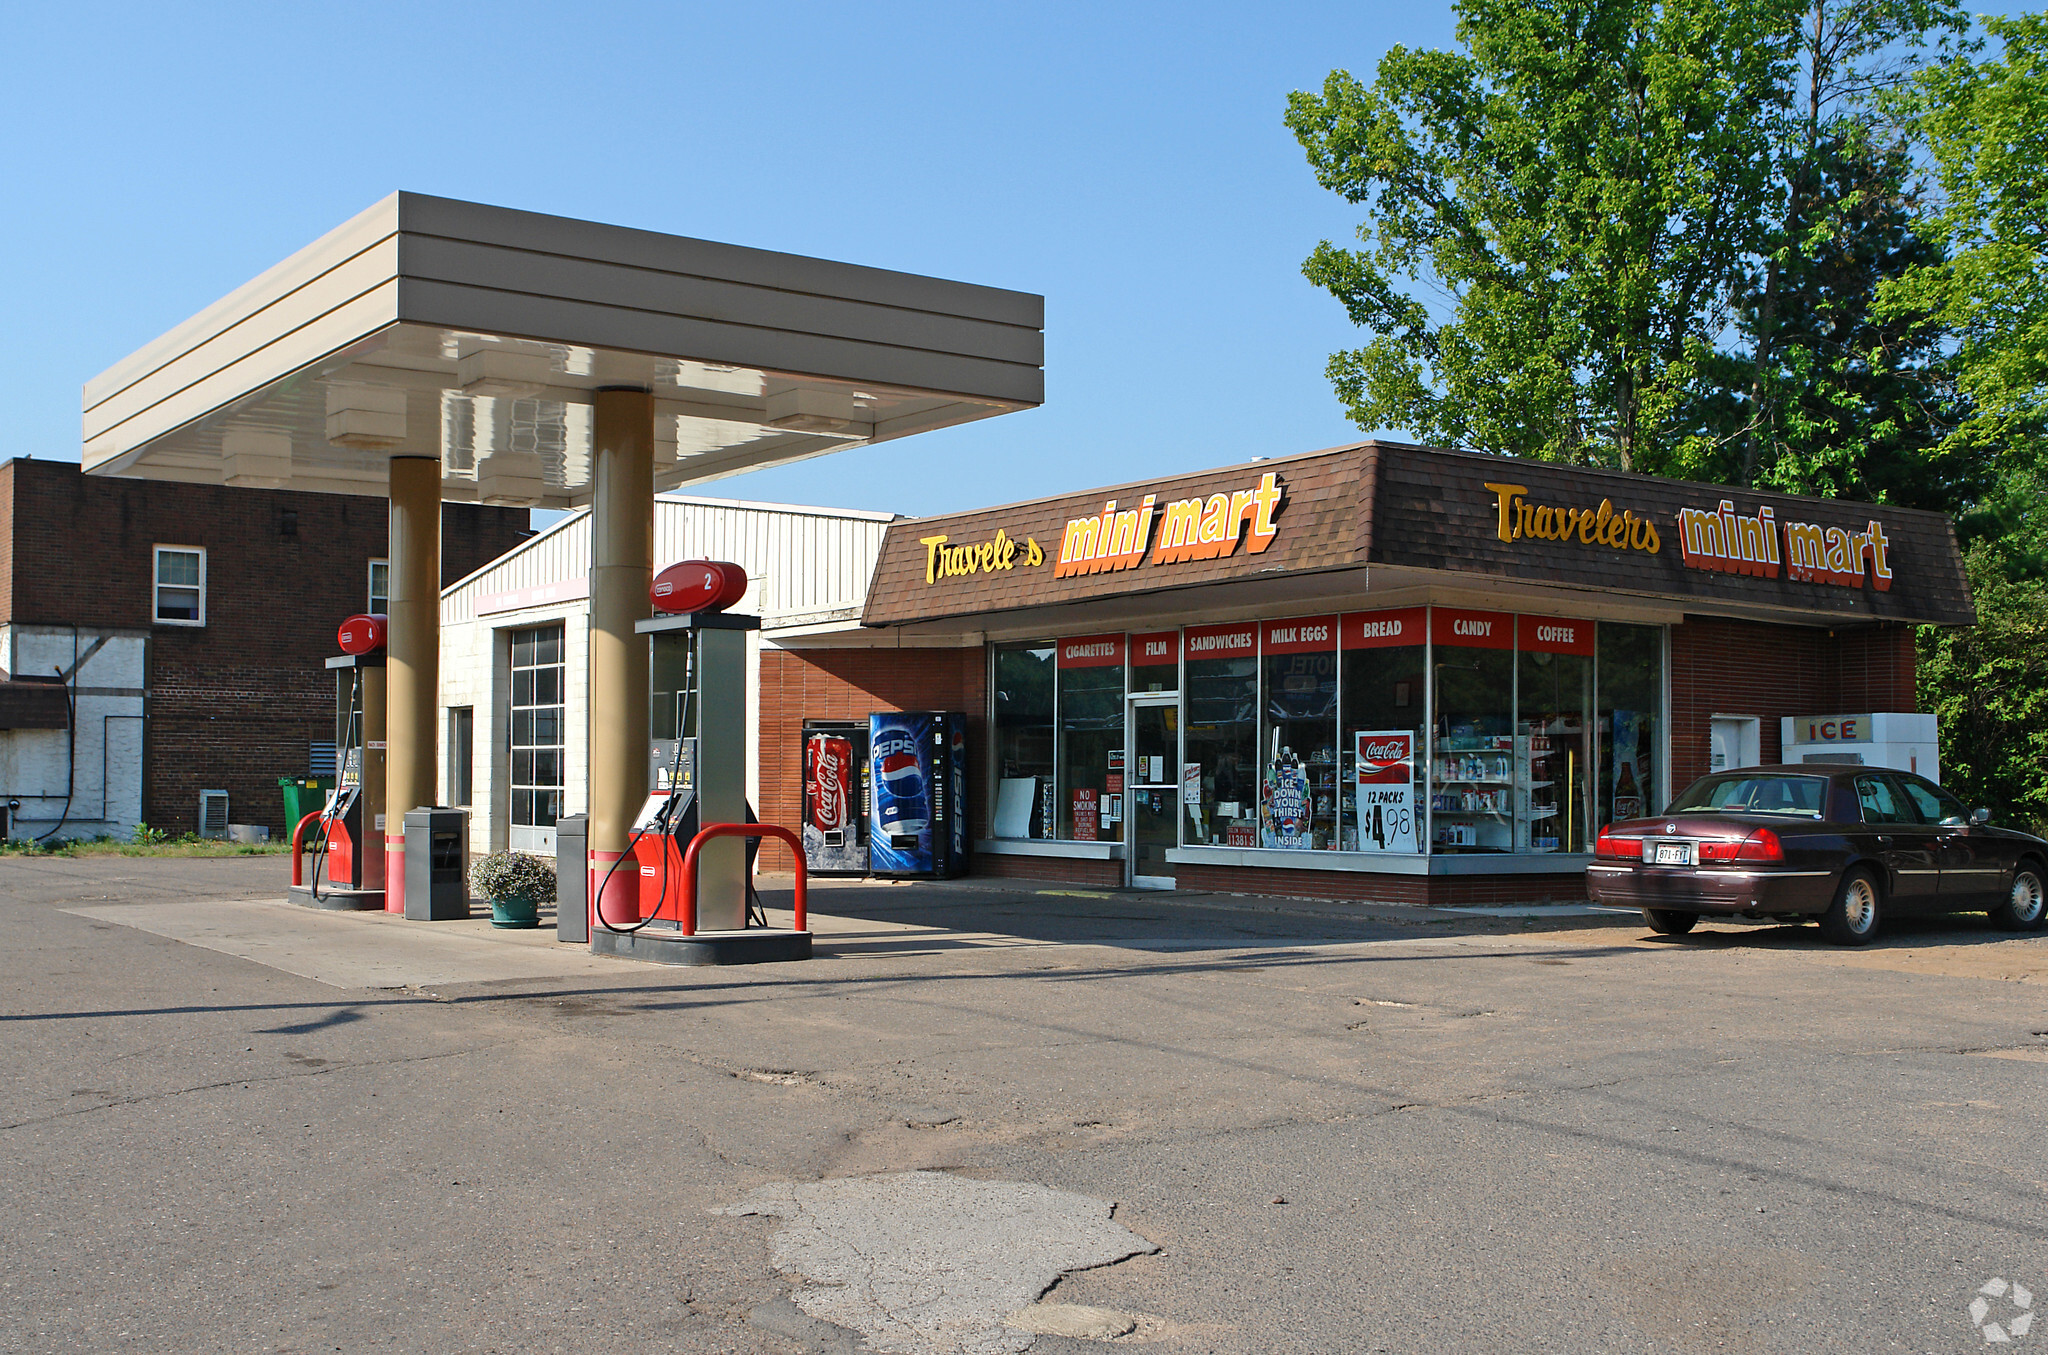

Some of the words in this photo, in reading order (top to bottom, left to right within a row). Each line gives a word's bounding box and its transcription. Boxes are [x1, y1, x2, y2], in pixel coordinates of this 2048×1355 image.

[1055, 494, 1157, 577] mini
[1154, 472, 1283, 562] mart
[1484, 482, 1661, 554] Travelers
[1680, 500, 1780, 576] mini
[1785, 520, 1893, 590] mart
[704, 573, 712, 590] 2
[1271, 628, 1297, 644] MILK
[1300, 625, 1328, 642] EGGS
[1363, 620, 1402, 638] BREAD
[1453, 619, 1492, 637] CANDY
[1537, 625, 1575, 643] COFFEE
[1065, 642, 1115, 659] CIGARETTES
[1145, 641, 1167, 656] FILM
[1190, 632, 1252, 652] SANDWICHES
[1810, 719, 1857, 740] ICE
[872, 739, 919, 760] PEPSI
[1366, 740, 1406, 760] Coca-Cola
[816, 751, 839, 826] Coca-Cola
[1079, 790, 1090, 800] NO
[1274, 789, 1300, 799] DOWN
[1367, 791, 1376, 804] 12
[1378, 791, 1405, 804] PACKS
[954, 767, 964, 855] PEPSI
[1073, 801, 1097, 811] SMOKING
[1276, 799, 1300, 808] YOUR
[1273, 808, 1302, 818] THIRST
[1228, 834, 1248, 846] 11381
[1249, 835, 1255, 846] S
[1274, 836, 1303, 846] INSIDE
